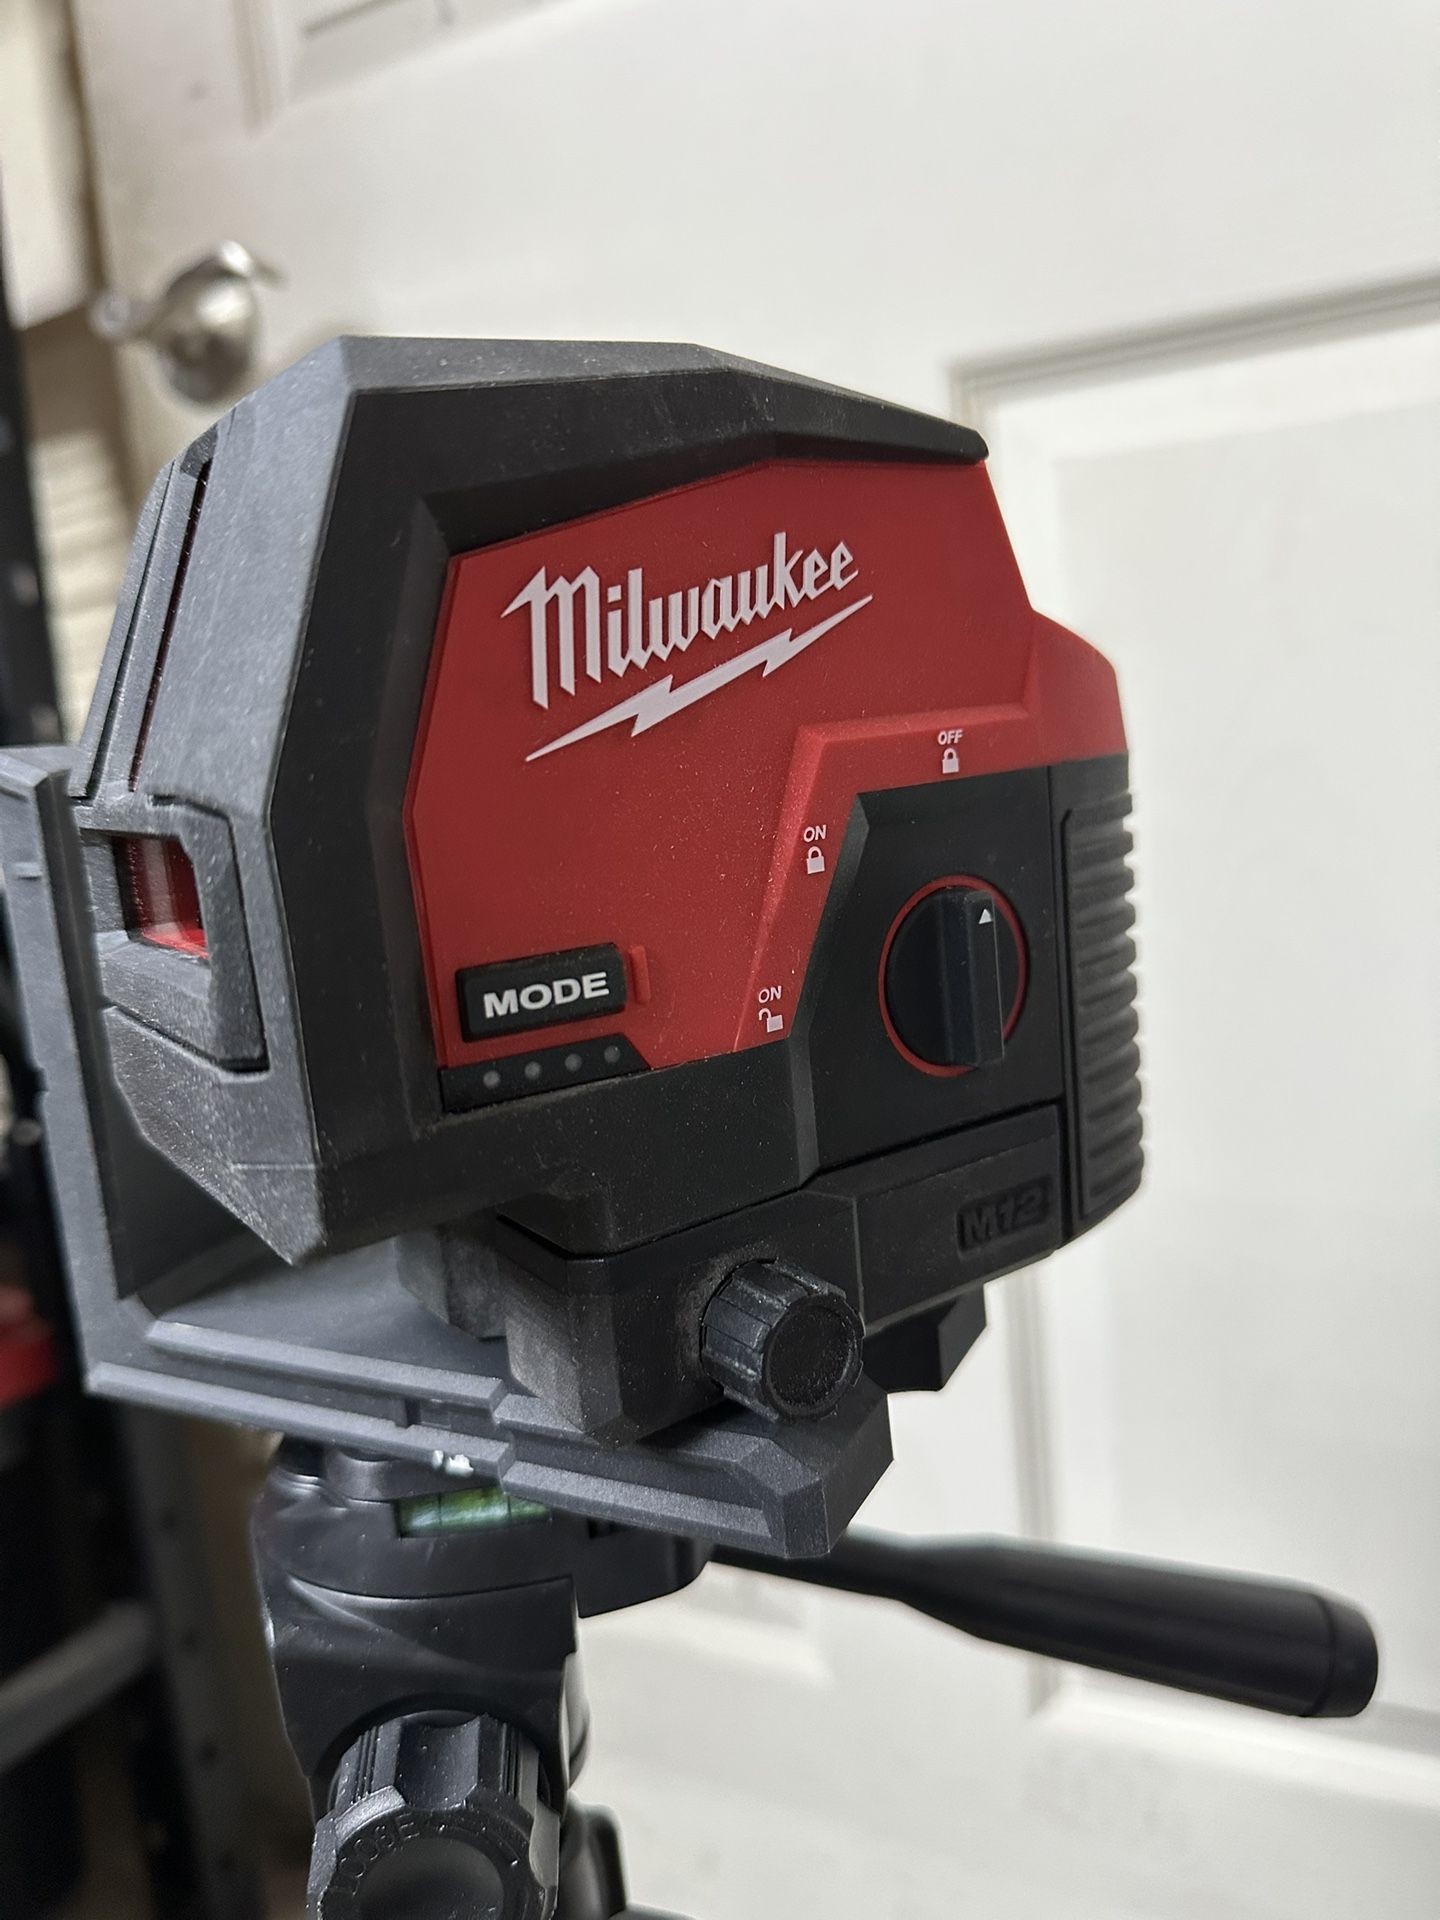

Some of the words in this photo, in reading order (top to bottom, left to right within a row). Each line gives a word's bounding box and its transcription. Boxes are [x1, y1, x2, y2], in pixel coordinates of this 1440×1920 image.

[501, 531, 859, 709] Milwaukee
[937, 729, 963, 745] OFF
[803, 824, 827, 842] ON
[483, 971, 610, 1019] MODE
[758, 985, 782, 1004] ON
[963, 1187, 1043, 1246] M12
